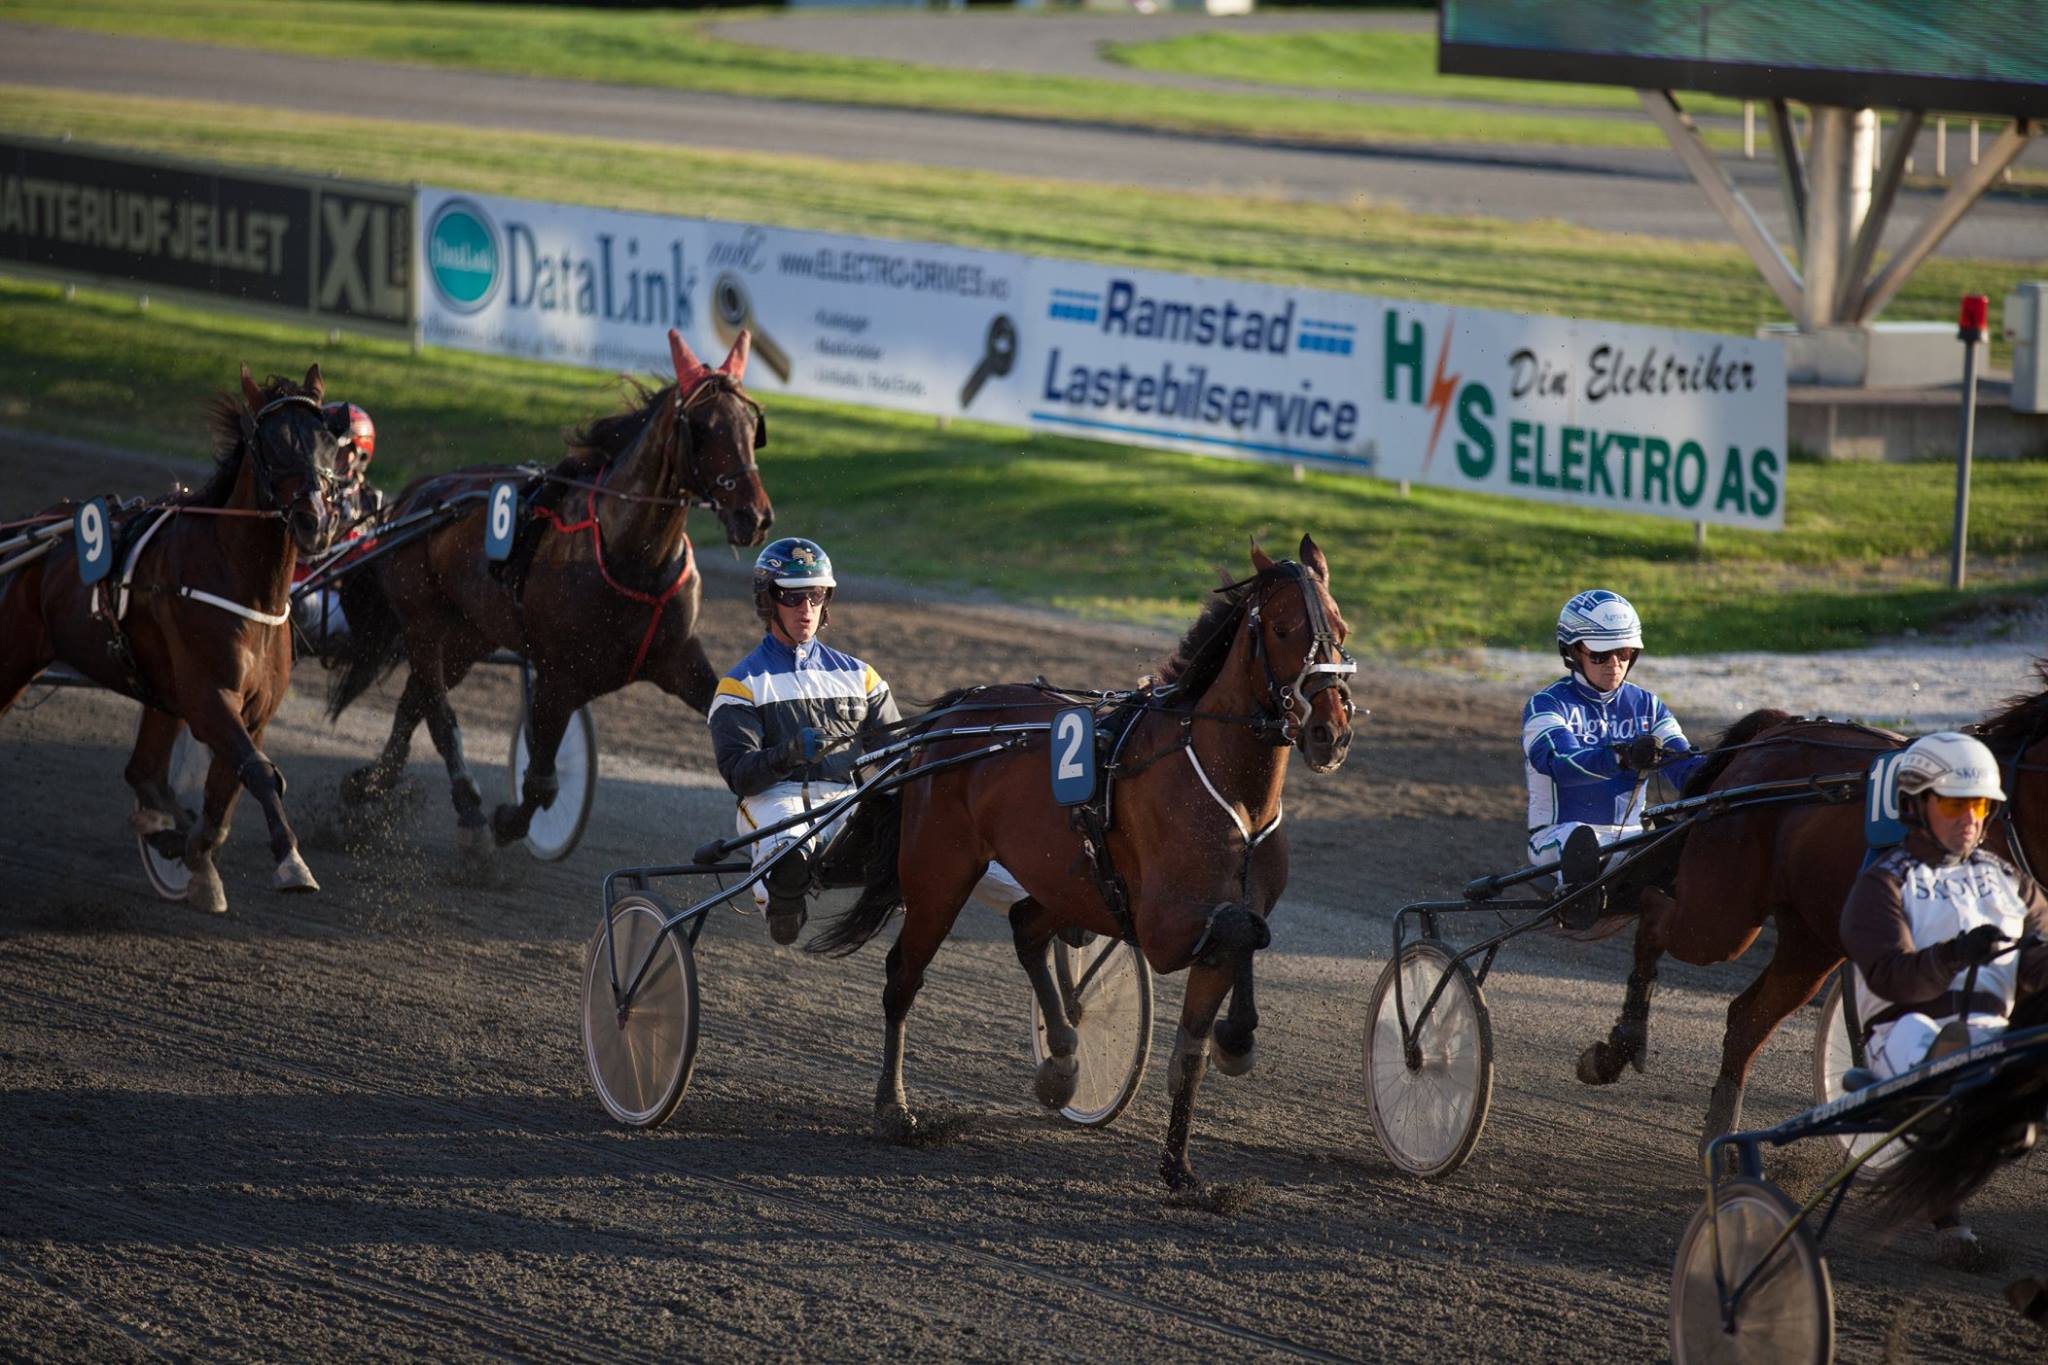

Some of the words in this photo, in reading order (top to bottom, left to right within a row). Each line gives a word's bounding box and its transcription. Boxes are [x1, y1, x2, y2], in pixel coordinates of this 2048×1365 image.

[504, 220, 698, 330] DataLink
[1103, 279, 1296, 355] Ramstad
[1043, 348, 1358, 441] Lastebilservice
[1509, 347, 1570, 399] Din
[1586, 343, 1757, 402] Elektriker
[1509, 420, 1708, 508] ELEKTRO
[1715, 447, 1779, 518] AS
[80, 502, 105, 562] 9
[491, 486, 512, 540] 6
[1057, 713, 1084, 780] 2
[1567, 706, 1636, 745] Agria
[1870, 753, 1904, 822] 10
